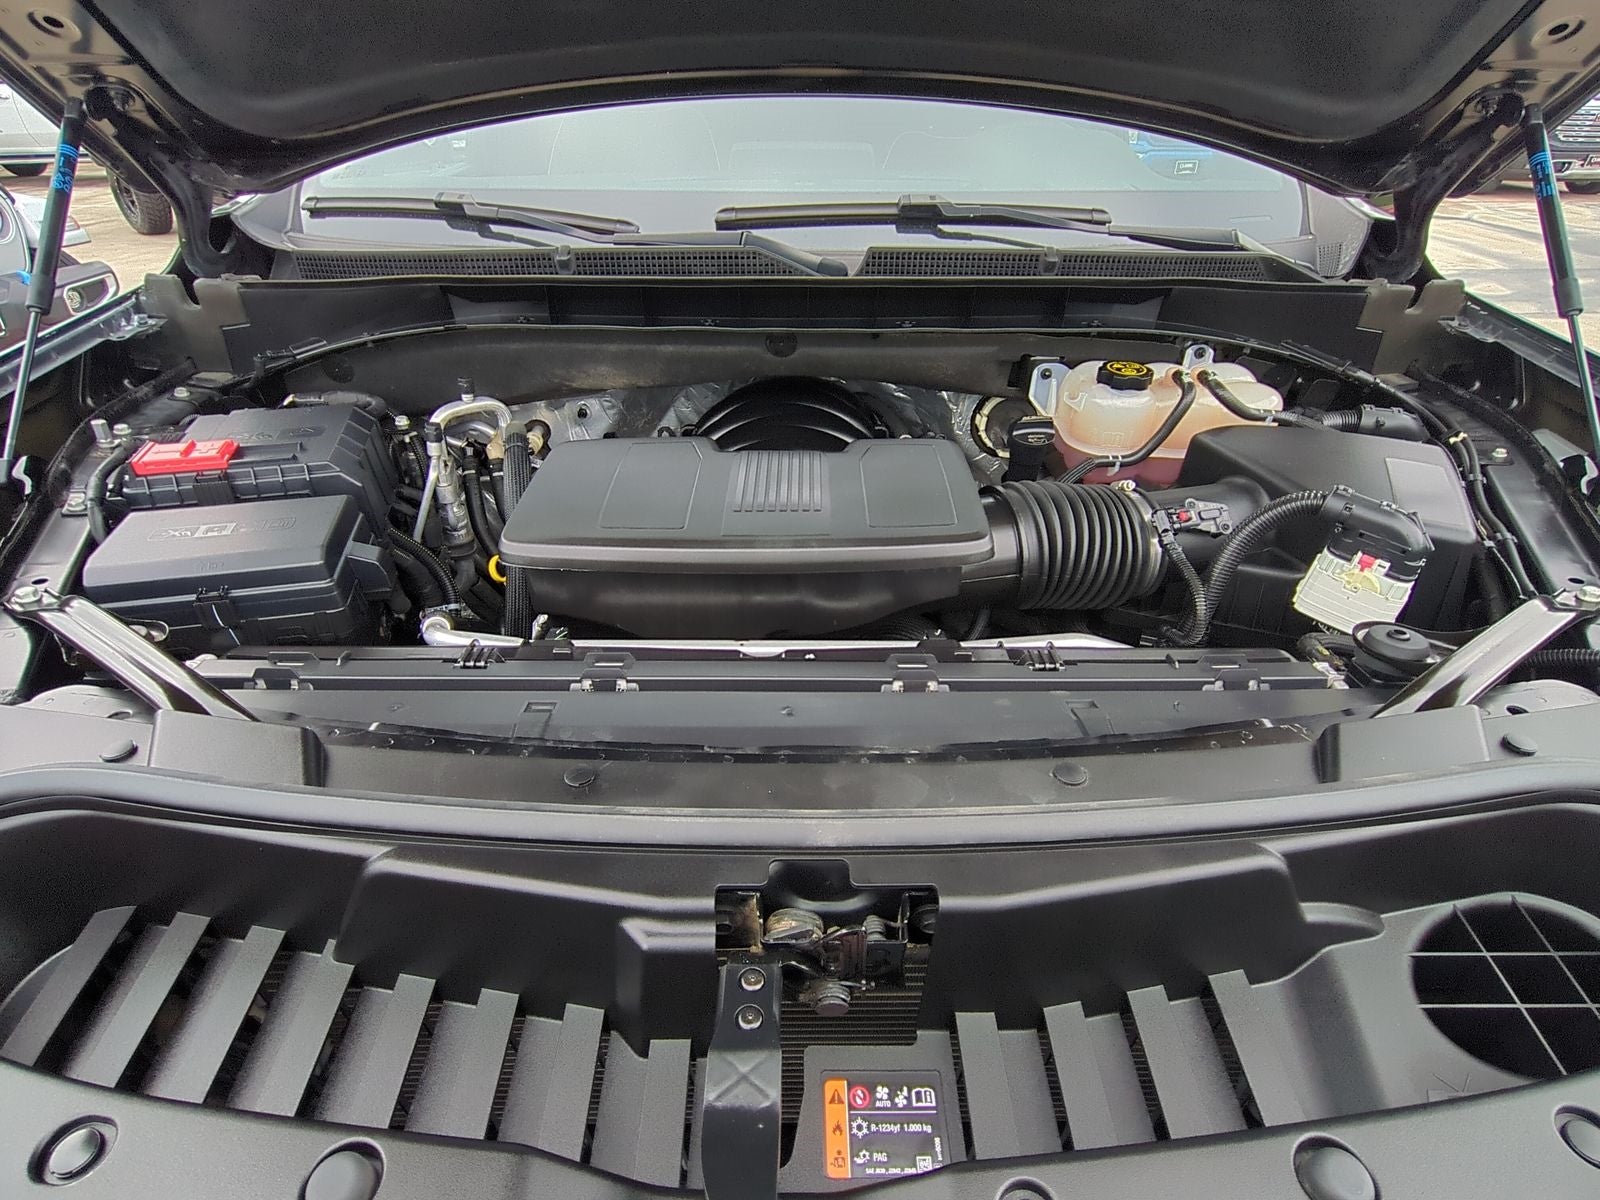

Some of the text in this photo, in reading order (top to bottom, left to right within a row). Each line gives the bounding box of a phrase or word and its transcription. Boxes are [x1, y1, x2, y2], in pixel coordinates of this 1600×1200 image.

[871, 1123, 932, 1133] R-1234yf 1.000 kg
[873, 1152, 888, 1162] PAG
